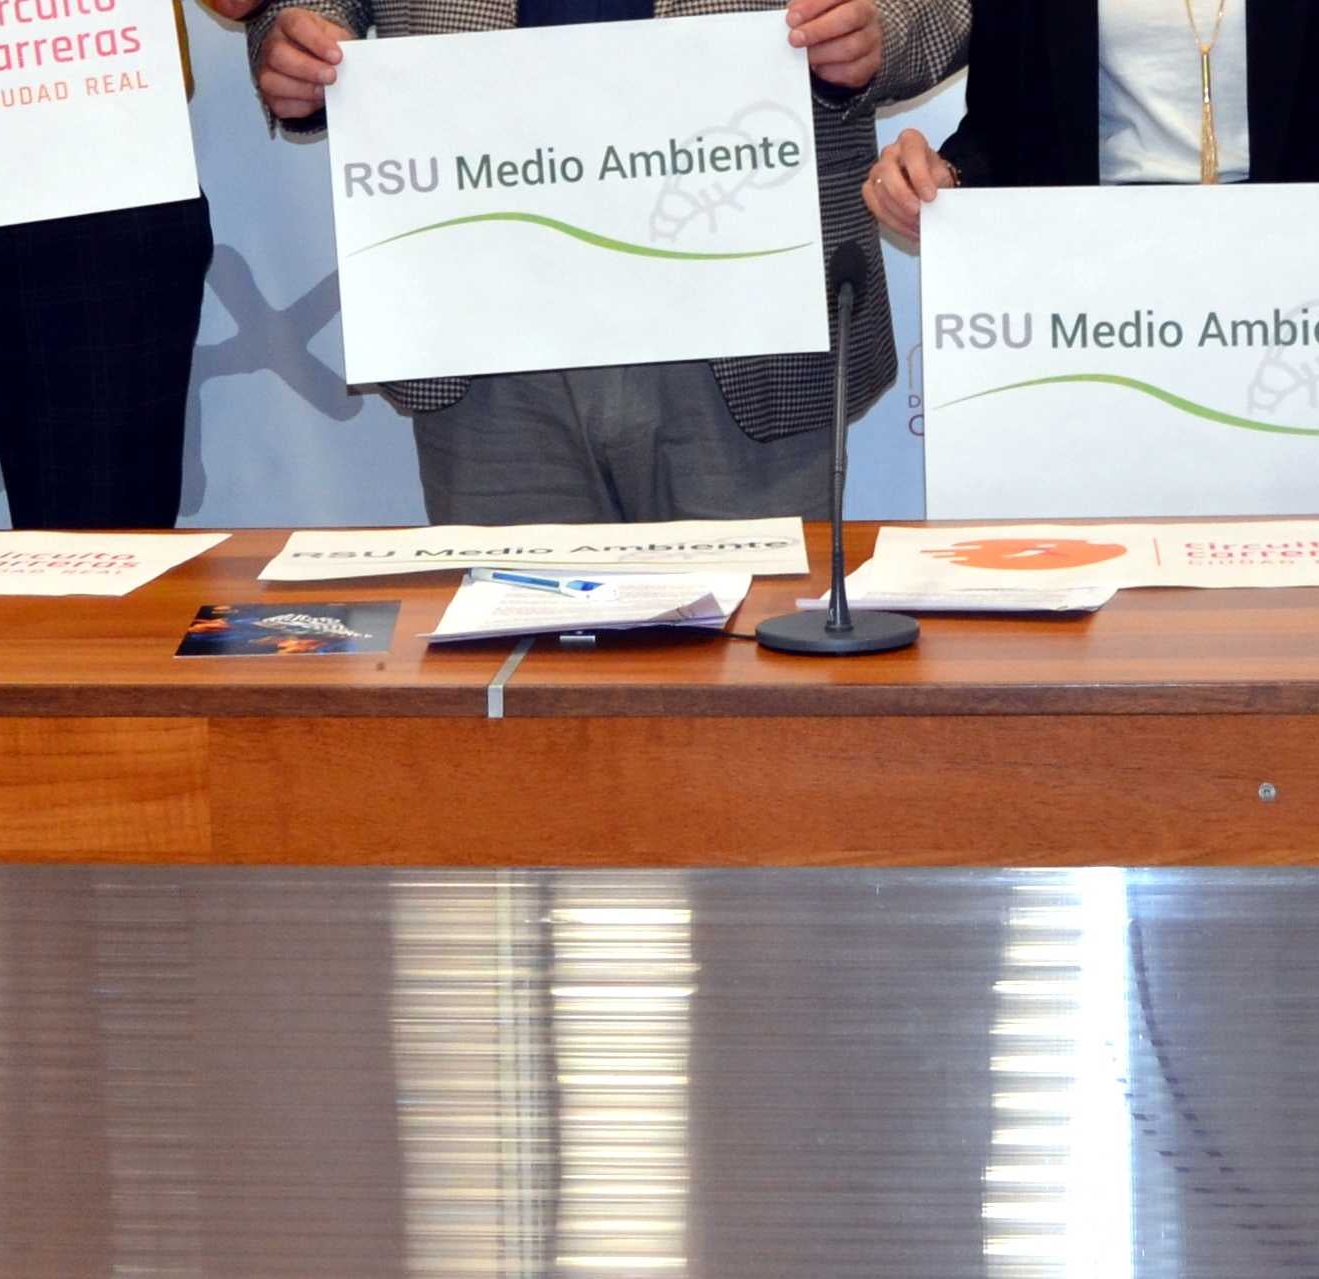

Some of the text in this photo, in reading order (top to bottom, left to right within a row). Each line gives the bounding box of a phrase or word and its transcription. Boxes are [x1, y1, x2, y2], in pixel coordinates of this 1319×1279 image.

[85, 70, 149, 96] REAL
[343, 135, 801, 198] RSU Medio Ambiente
[934, 312, 1033, 350] RSU
[1050, 308, 1184, 349] Medio
[290, 550, 397, 559] RSU
[414, 546, 555, 557] Medio
